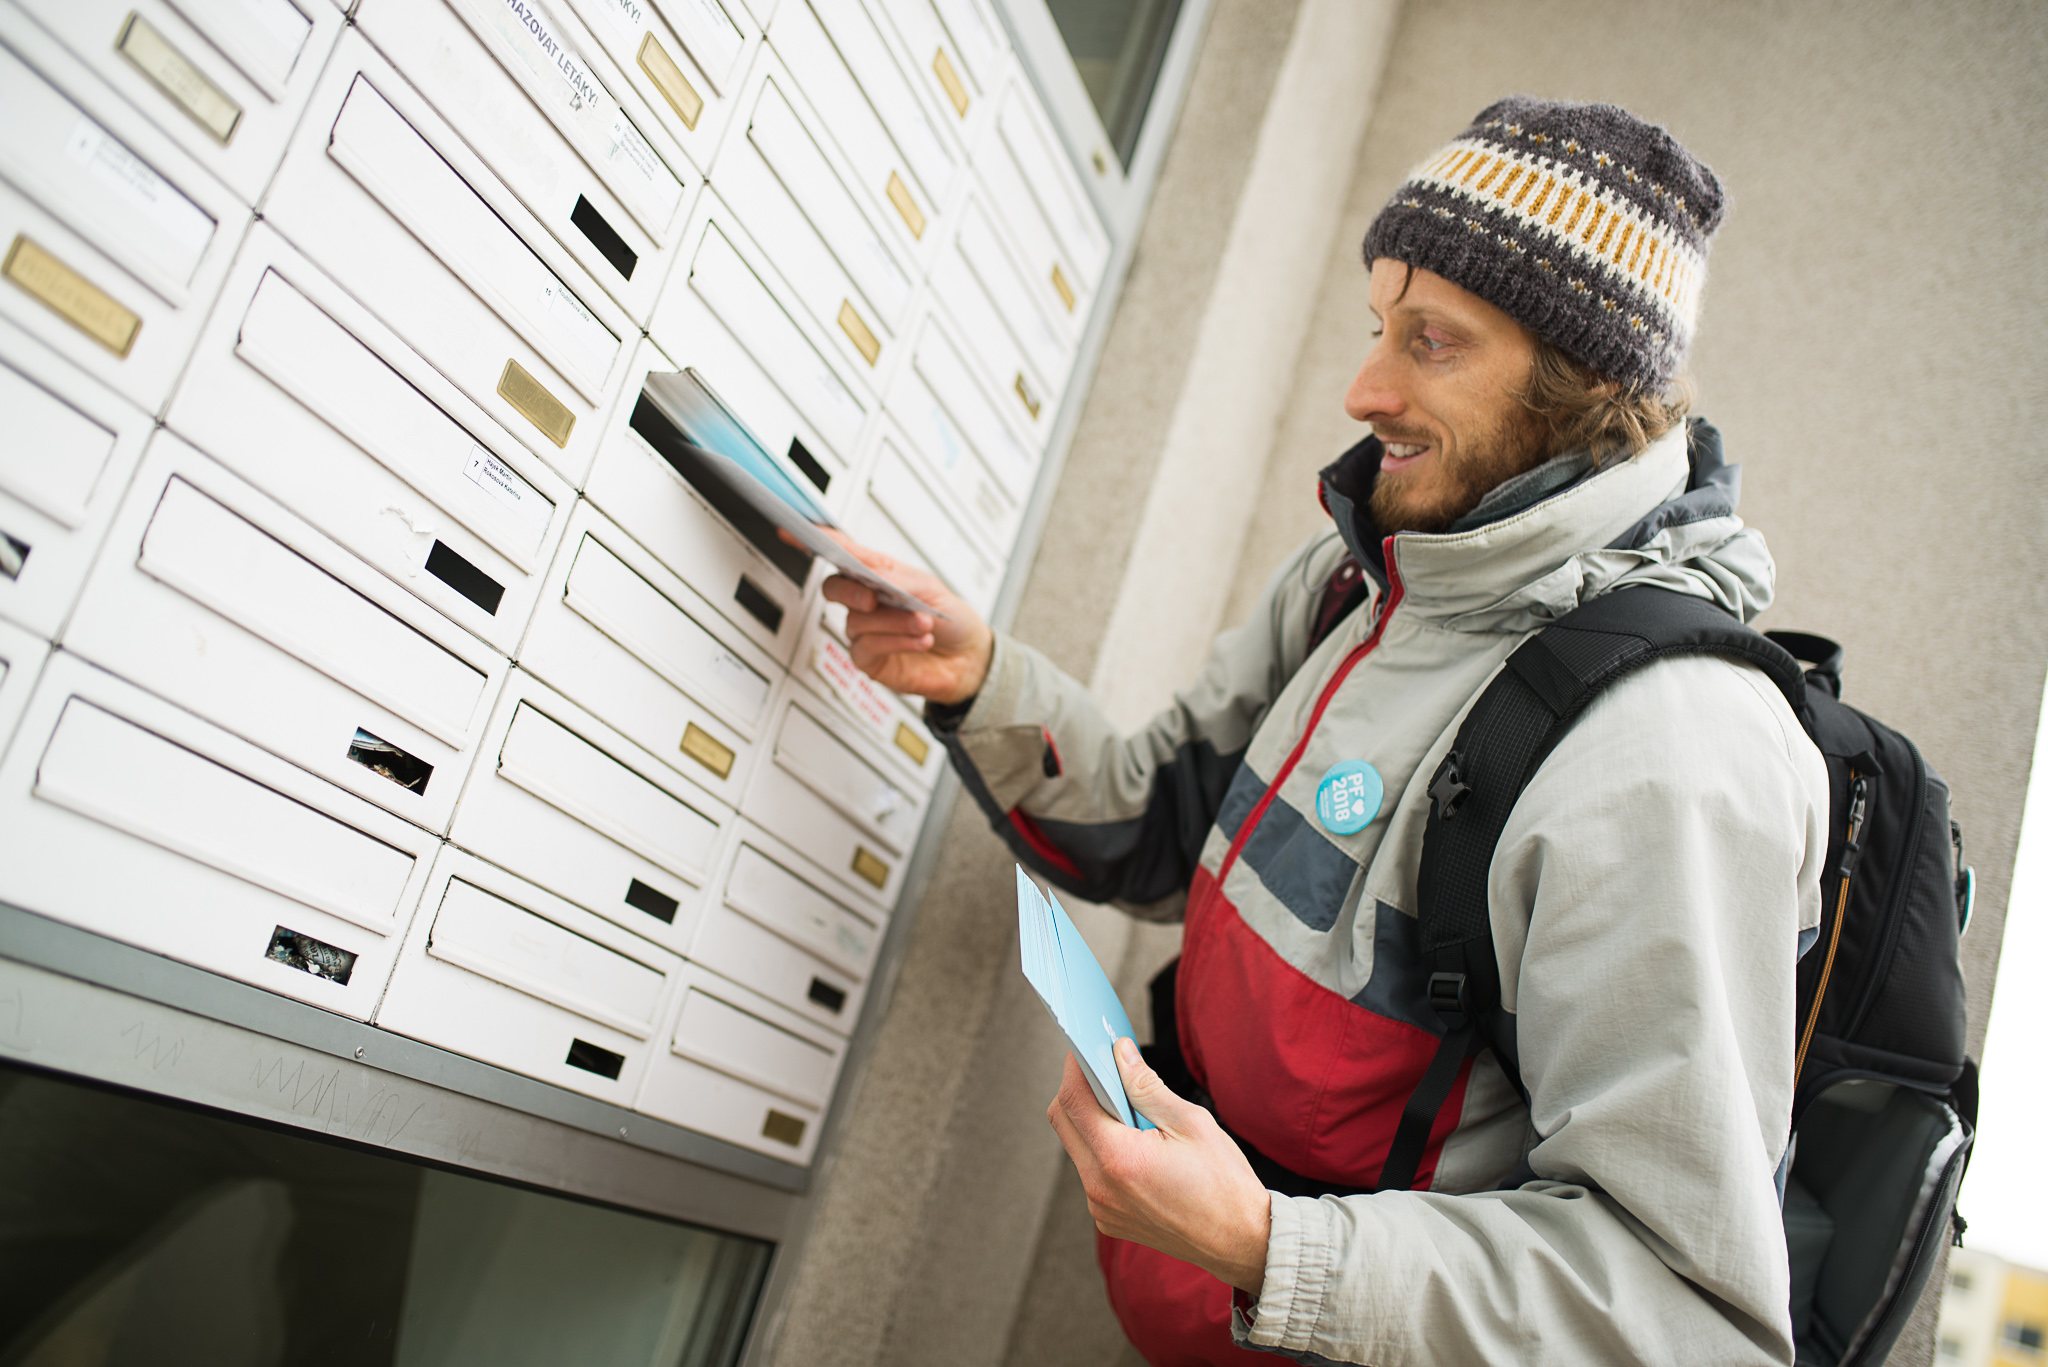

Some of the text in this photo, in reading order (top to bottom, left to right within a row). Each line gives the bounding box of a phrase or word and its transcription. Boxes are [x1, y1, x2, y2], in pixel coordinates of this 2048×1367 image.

[557, 53, 599, 108] LETÁKY!
[1332, 778, 1350, 822] 2018
[1348, 773, 1364, 797] PF
